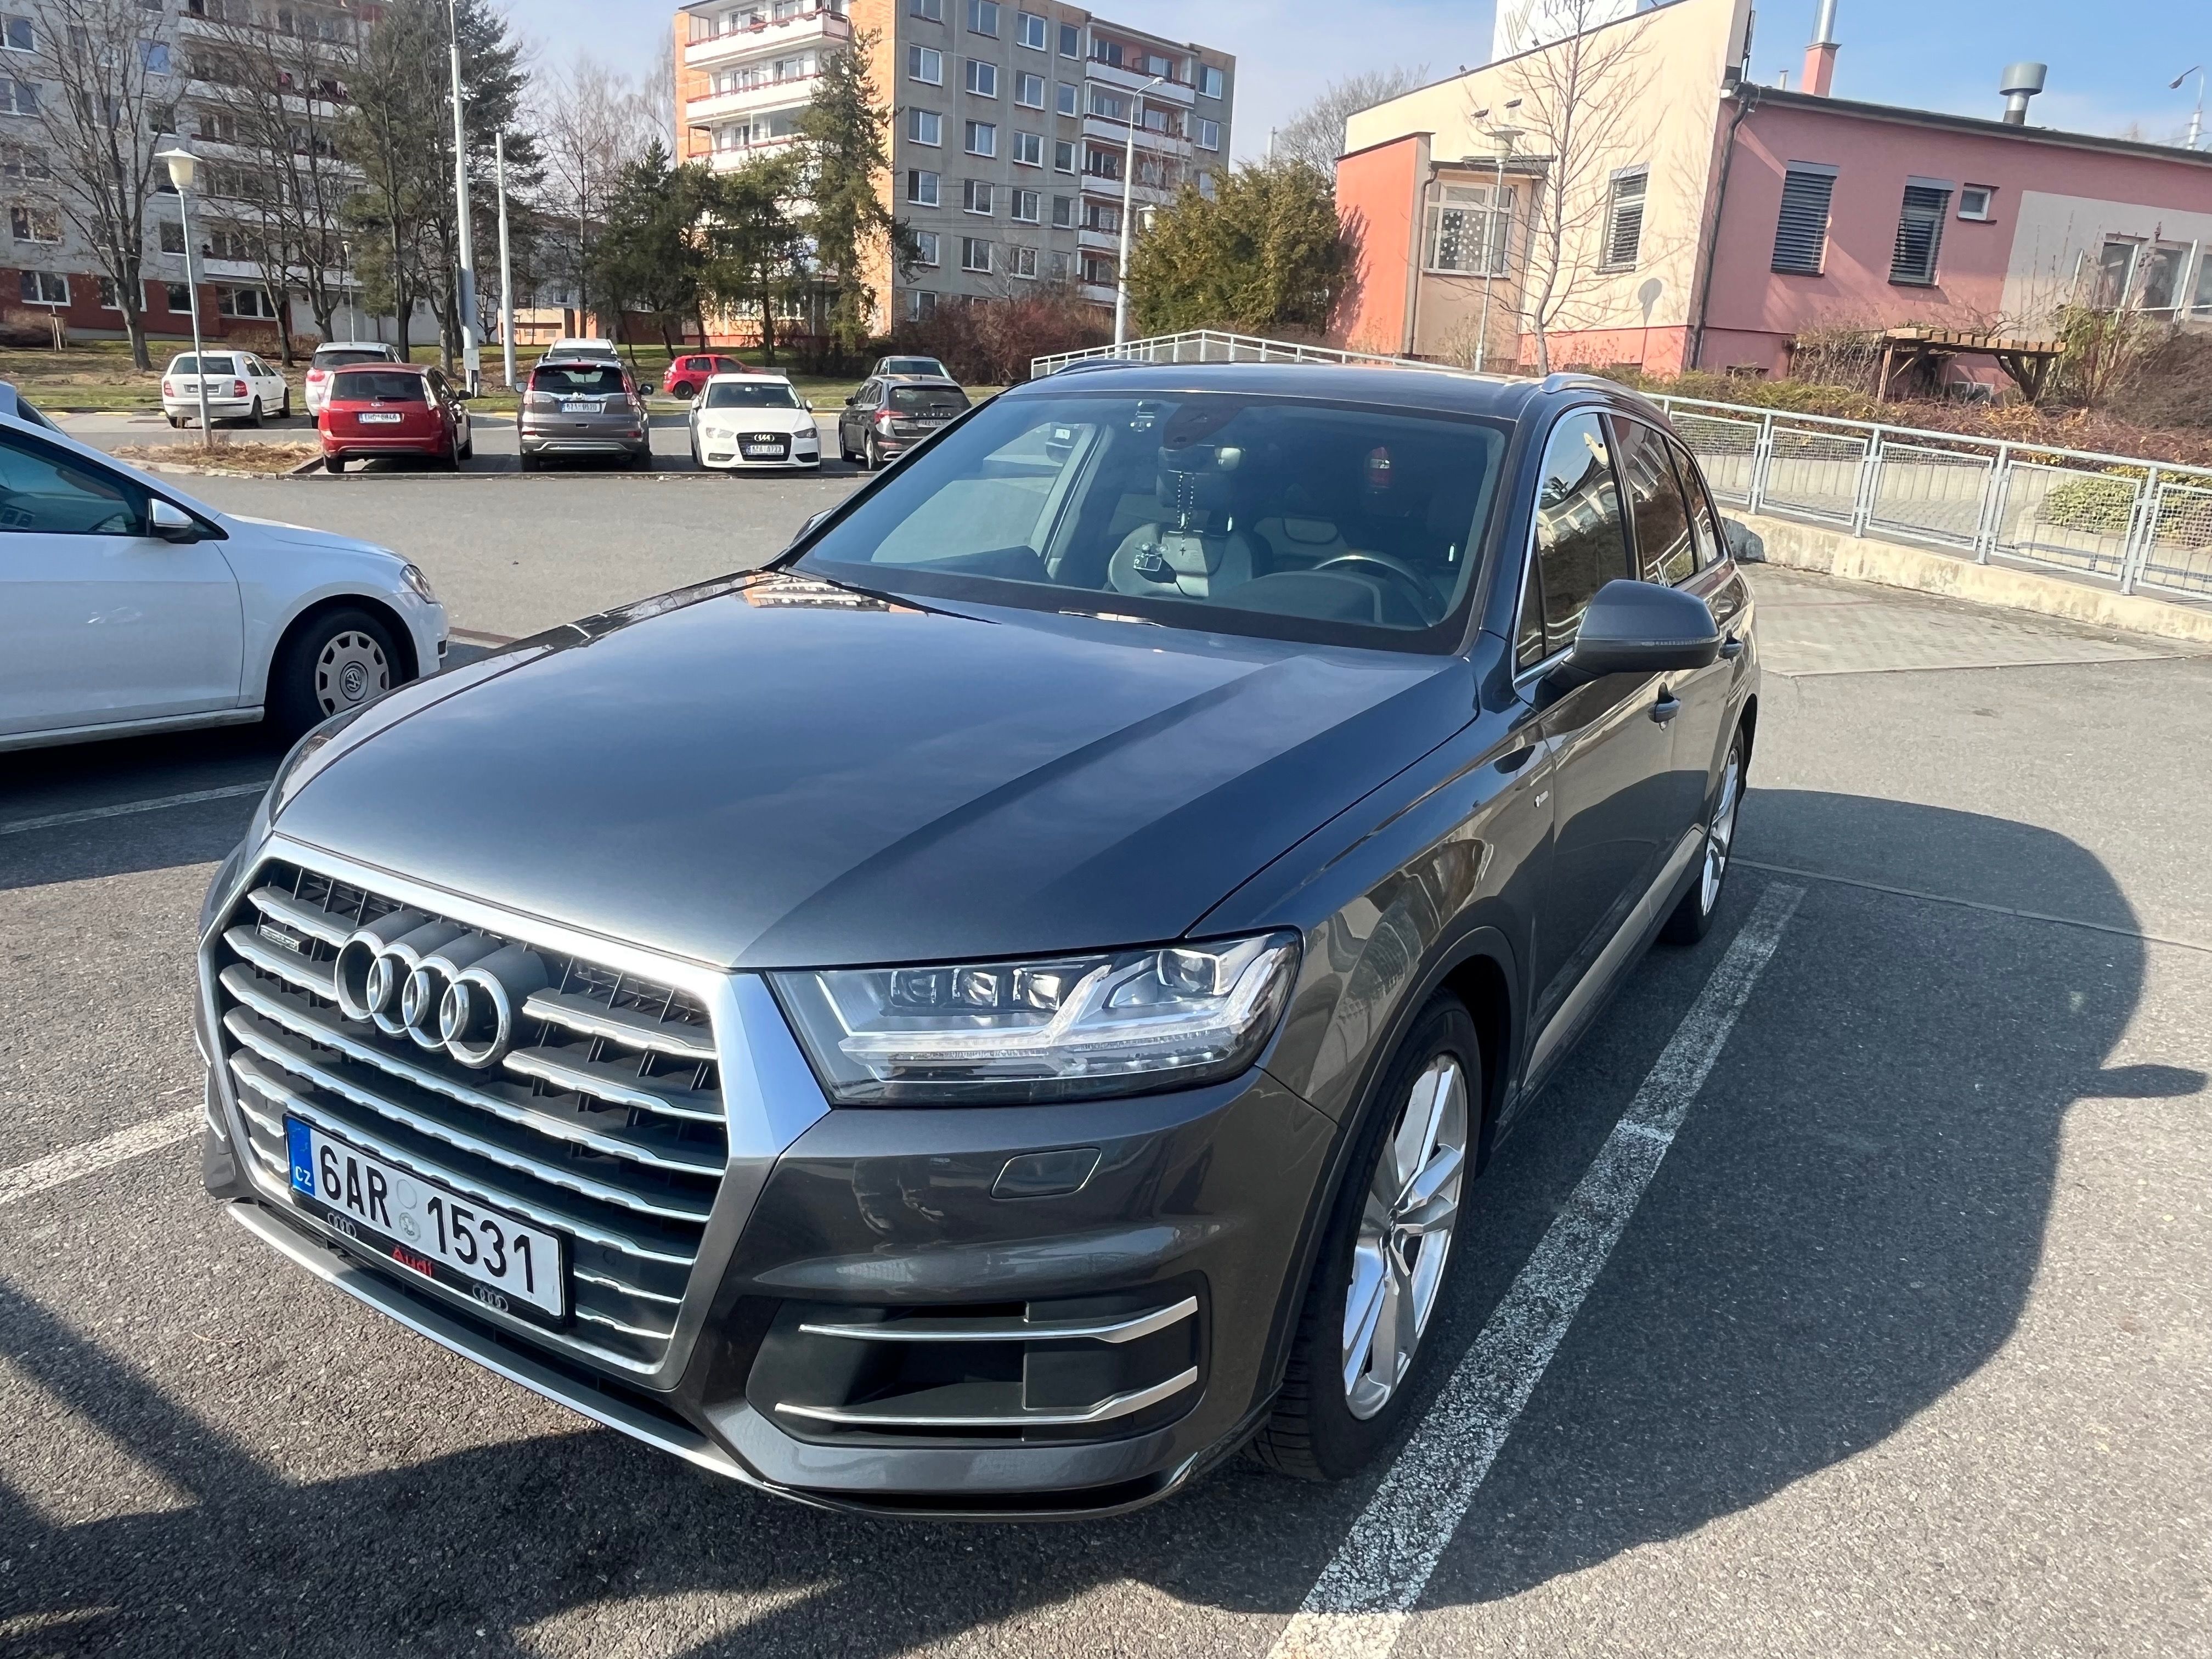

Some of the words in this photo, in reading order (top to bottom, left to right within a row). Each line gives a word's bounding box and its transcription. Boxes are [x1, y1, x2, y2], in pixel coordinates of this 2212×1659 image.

[295, 1166, 312, 1187] CZ
[320, 1144, 392, 1229] 6AR
[427, 1196, 535, 1294] 1531
